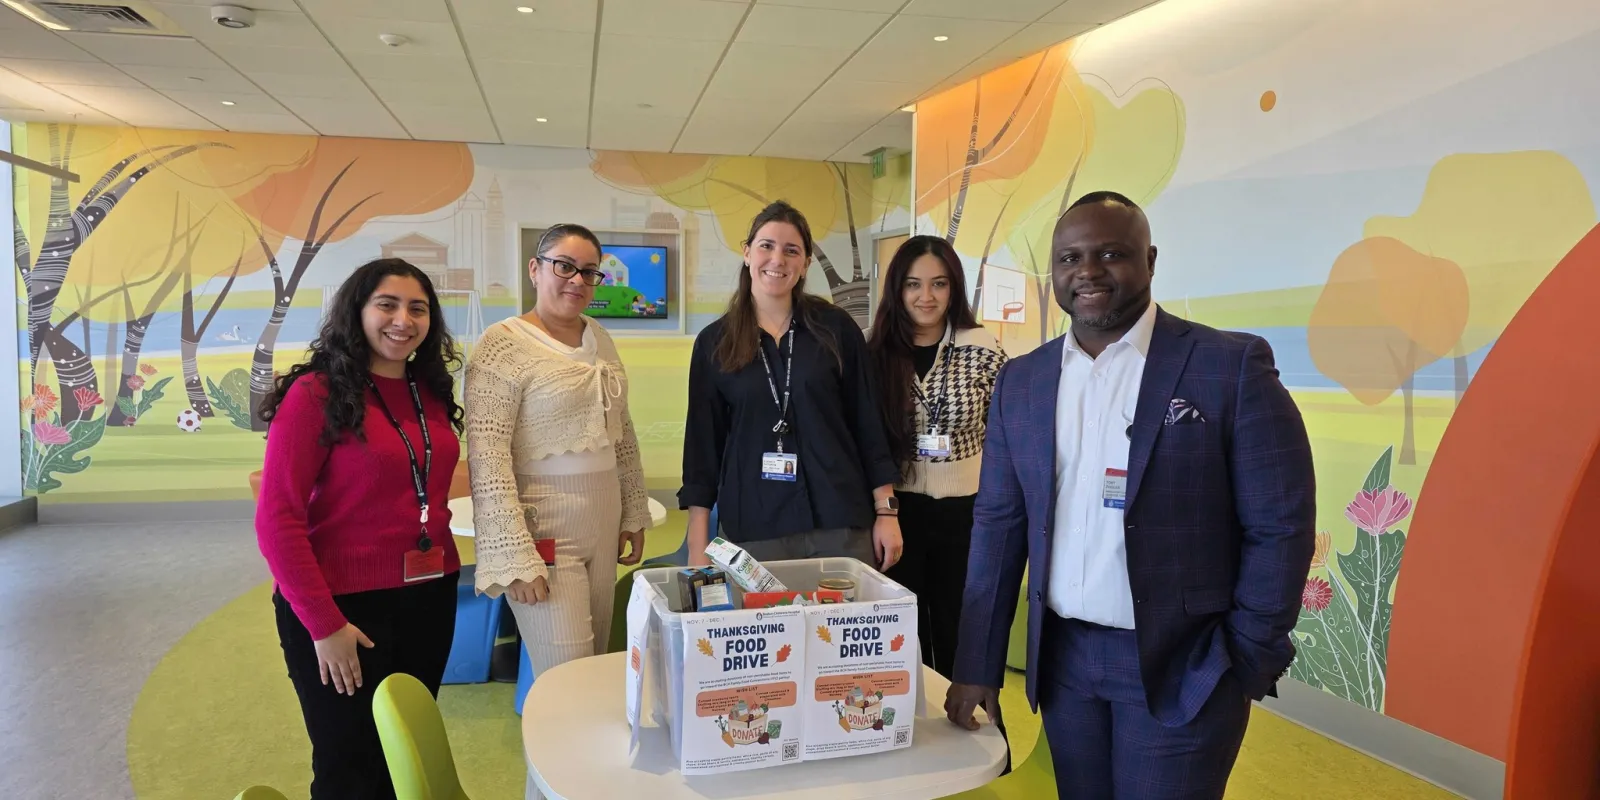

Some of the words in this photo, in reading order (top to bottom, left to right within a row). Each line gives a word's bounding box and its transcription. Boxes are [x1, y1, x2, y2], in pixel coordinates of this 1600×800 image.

[736, 555, 752, 573] Kashi
[745, 564, 753, 574] GO
[826, 614, 898, 626] THANKSGIVING
[707, 623, 784, 638] THANKSGIVING
[842, 626, 880, 642] FOOD
[726, 638, 766, 654] FOOD
[840, 642, 883, 658] DRIVE
[723, 653, 768, 672] DRIVE
[848, 712, 877, 726] DONATE
[732, 726, 763, 740] DONATE
